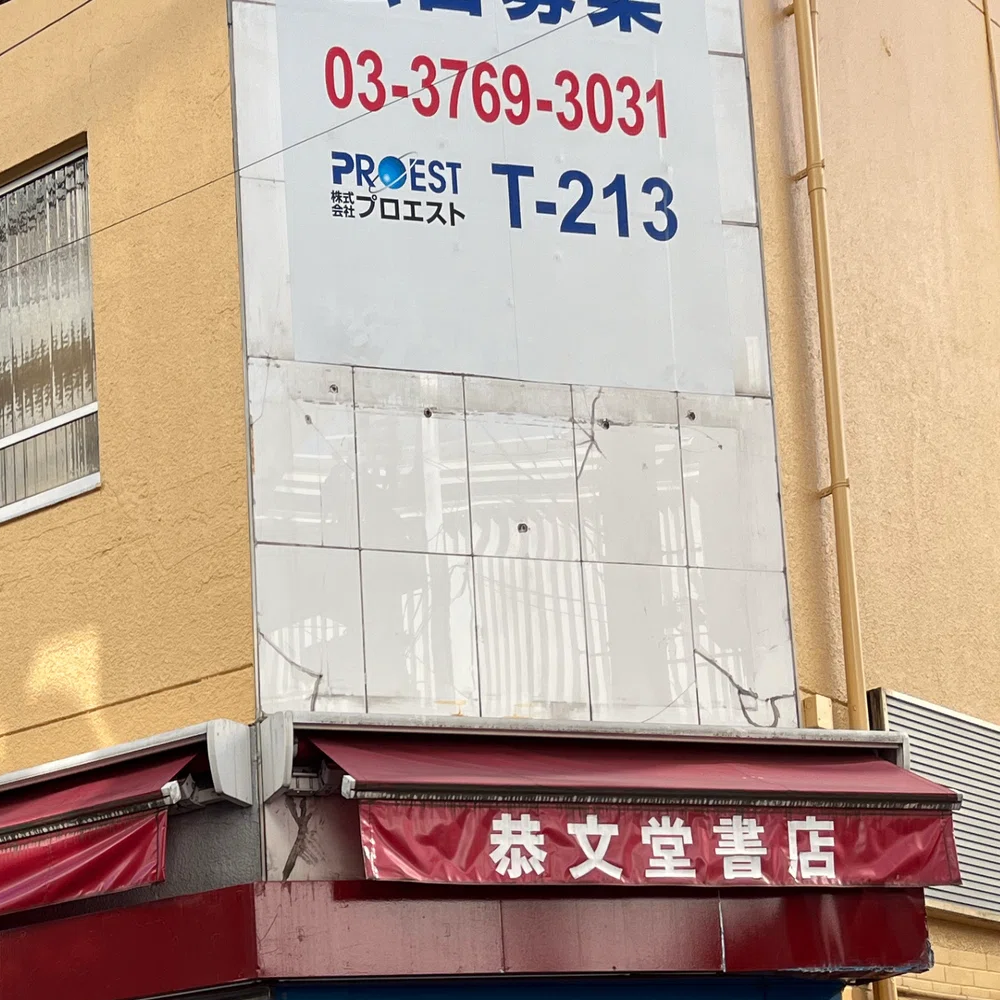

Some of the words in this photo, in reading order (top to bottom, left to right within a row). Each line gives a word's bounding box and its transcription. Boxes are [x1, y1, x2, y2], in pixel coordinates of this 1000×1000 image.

[325, 46, 668, 139] 03-3769-3031
[358, 195, 466, 226] プロエスト
[491, 163, 678, 242] T-213
[488, 813, 836, 881] 恭文堂書店
